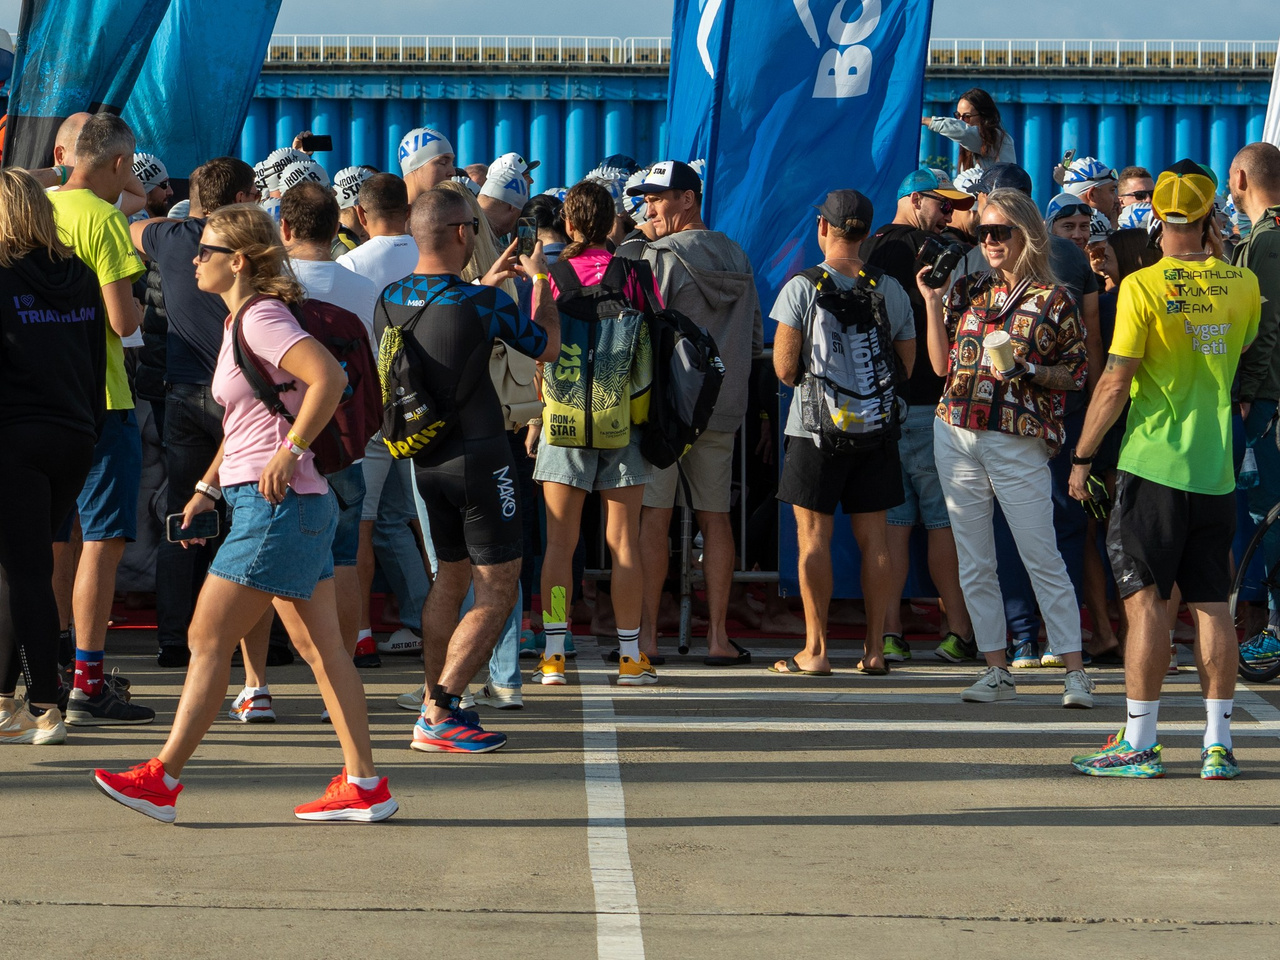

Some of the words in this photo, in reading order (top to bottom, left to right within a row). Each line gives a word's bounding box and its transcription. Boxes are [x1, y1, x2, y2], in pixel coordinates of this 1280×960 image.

[399, 131, 441, 163] AVA
[137, 162, 162, 182] TAR
[339, 174, 358, 188] IRON
[342, 179, 364, 200] STA
[1173, 268, 1243, 280] TRIATHLON
[1174, 284, 1228, 297] TYUMEN
[1175, 300, 1213, 314] TEAM
[555, 343, 581, 383] 113
[550, 413, 569, 425] IRON
[550, 424, 577, 437] STAR
[493, 465, 516, 517] MAKO
